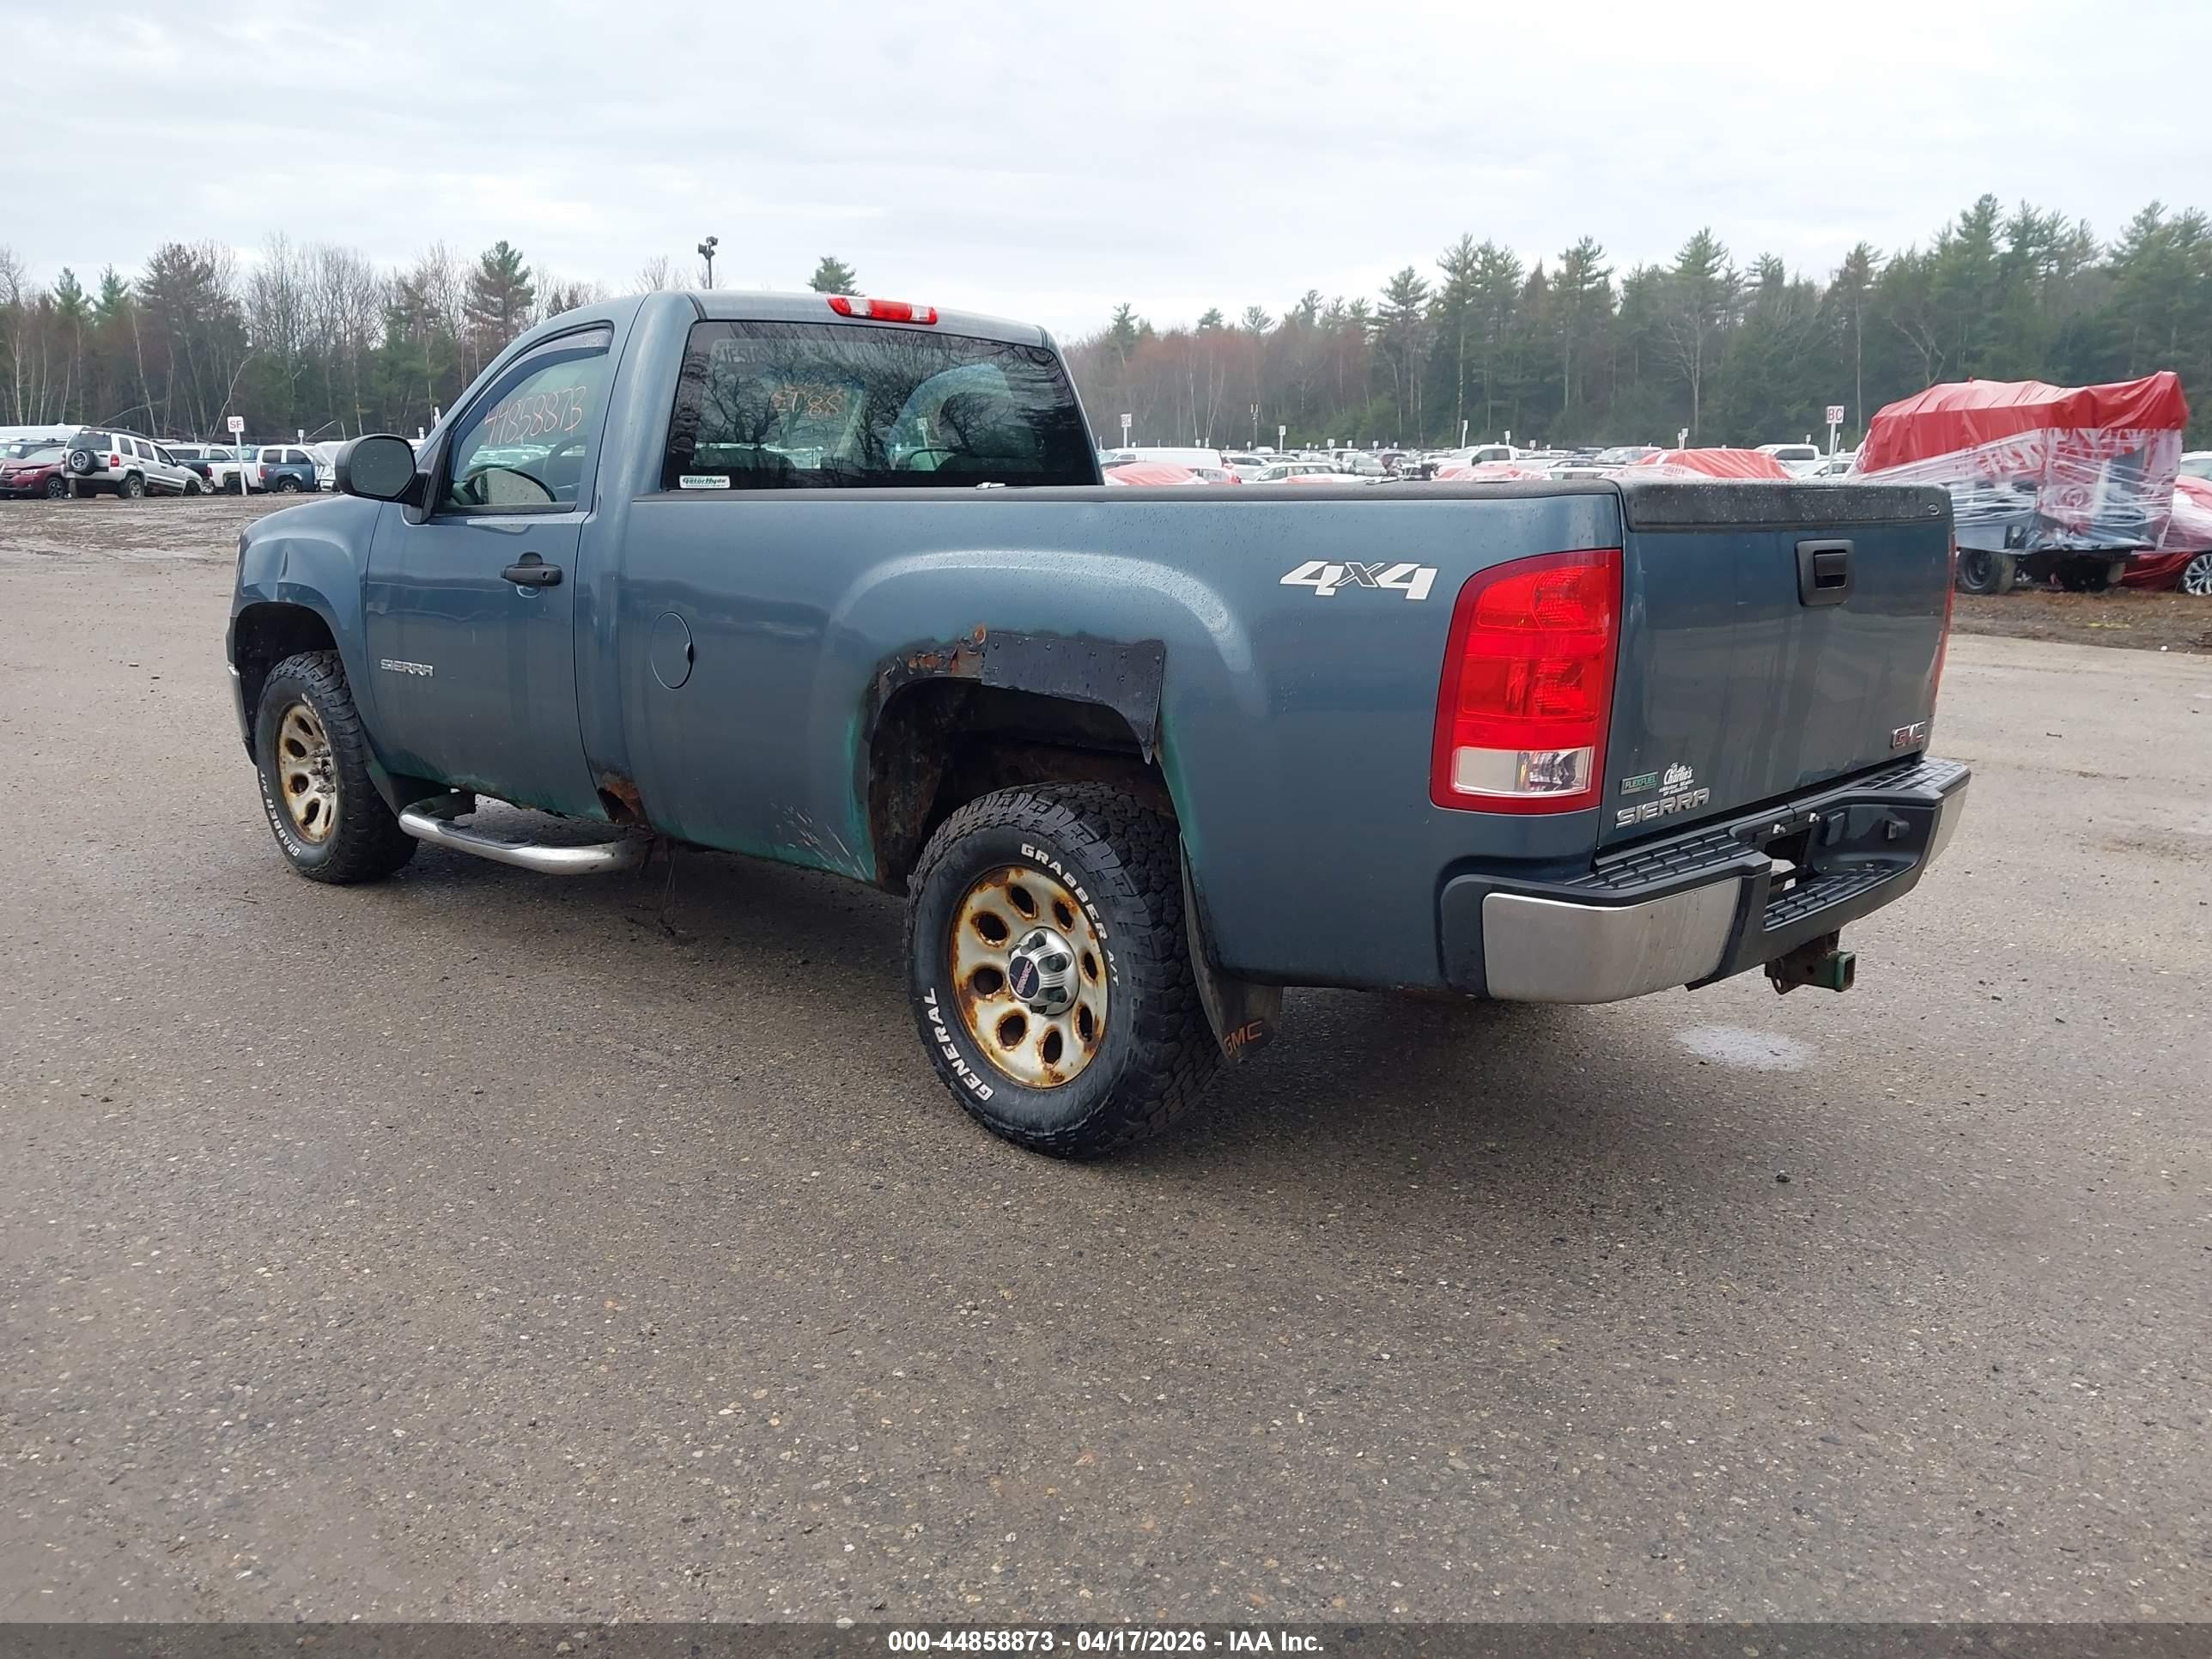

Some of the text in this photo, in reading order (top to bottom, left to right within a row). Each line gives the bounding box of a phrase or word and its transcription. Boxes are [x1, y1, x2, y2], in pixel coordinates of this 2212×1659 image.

[229, 420, 241, 429] SF
[1828, 408, 1843, 421] BC
[380, 659, 434, 678] SIERRA
[1615, 787, 1710, 830] SIERRA
[1021, 842, 1109, 939] GRABBER
[923, 987, 994, 1102] GENERAL
[1224, 1020, 1263, 1056] GMC
